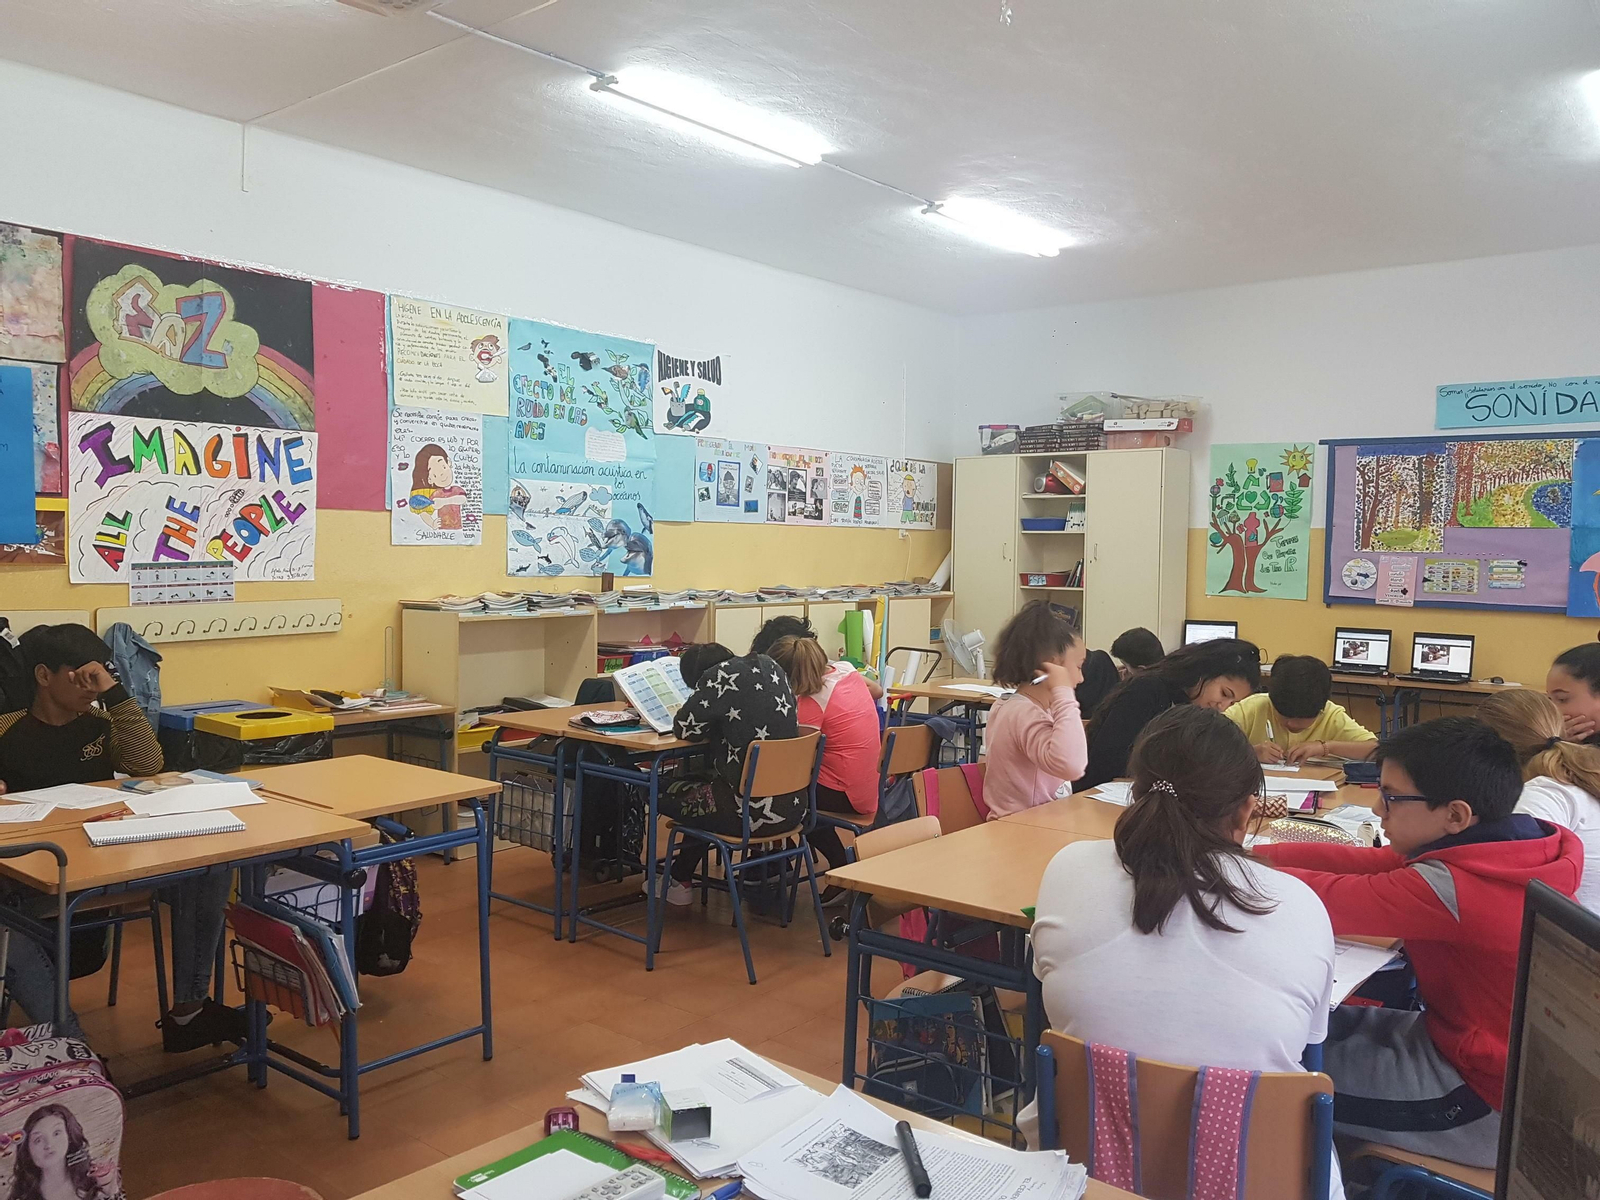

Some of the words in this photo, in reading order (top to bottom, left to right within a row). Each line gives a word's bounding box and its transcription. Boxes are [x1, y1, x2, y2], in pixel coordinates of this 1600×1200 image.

[430, 306, 442, 319] EN
[444, 310, 452, 321] LA
[557, 362, 575, 386] EL
[657, 349, 690, 383] HIGIENE
[690, 360, 696, 377] Y
[554, 403, 566, 419] EN
[568, 405, 588, 426] LAS
[515, 420, 546, 440] AVES
[513, 445, 527, 474] La
[634, 470, 648, 480] en
[614, 477, 625, 489] los
[152, 495, 200, 562] THE
[206, 489, 308, 563] PEOPLE
[92, 510, 133, 572] ALL
